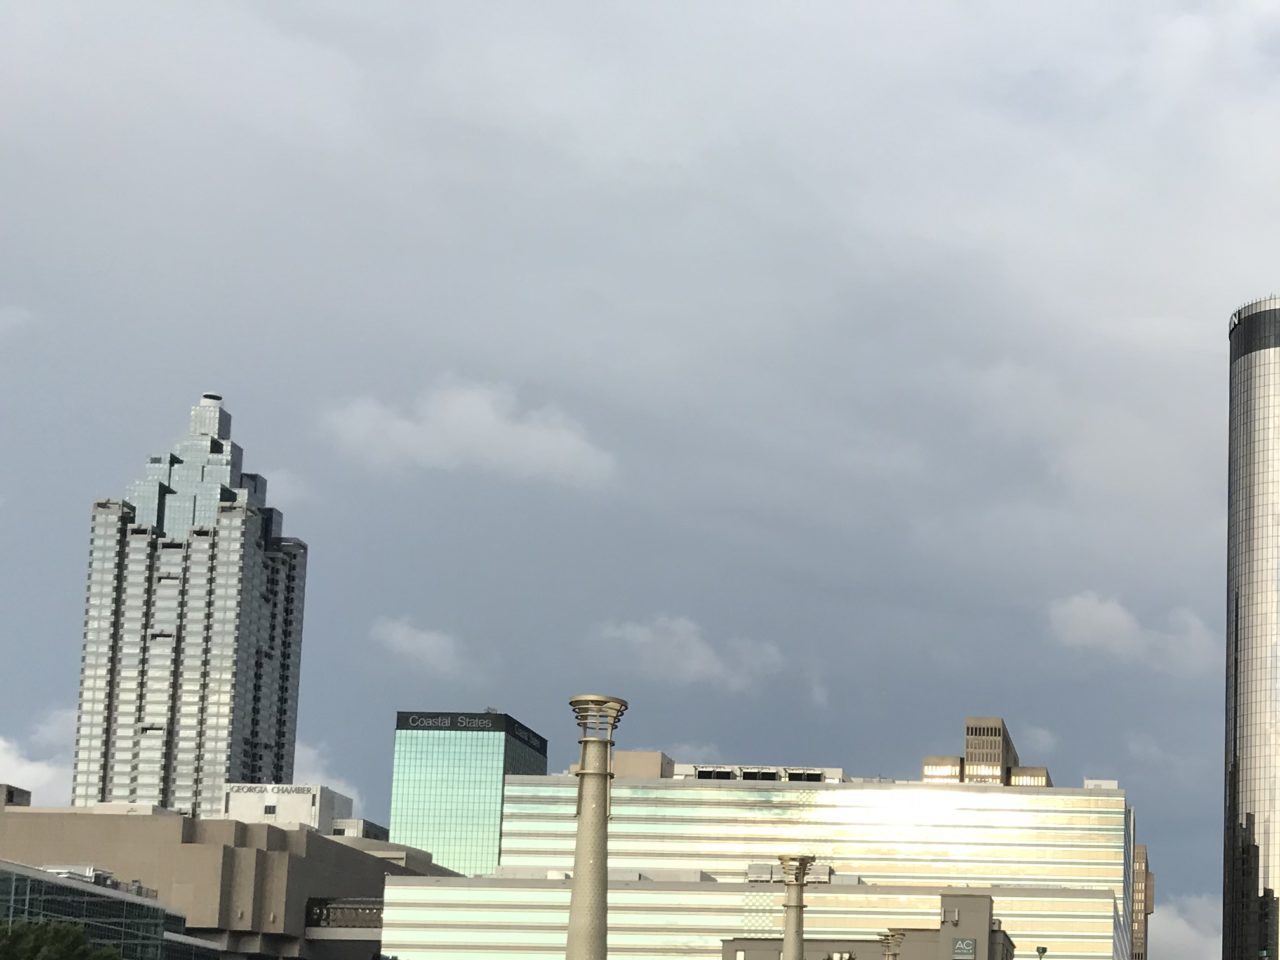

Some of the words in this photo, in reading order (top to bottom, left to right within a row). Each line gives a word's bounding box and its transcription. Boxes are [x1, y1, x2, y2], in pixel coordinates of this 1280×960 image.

[408, 715, 451, 727] Coastal
[457, 716, 492, 728] States
[230, 785, 269, 794] GEORGIA
[271, 786, 312, 795] CHAMBER
[955, 940, 973, 950] AC
